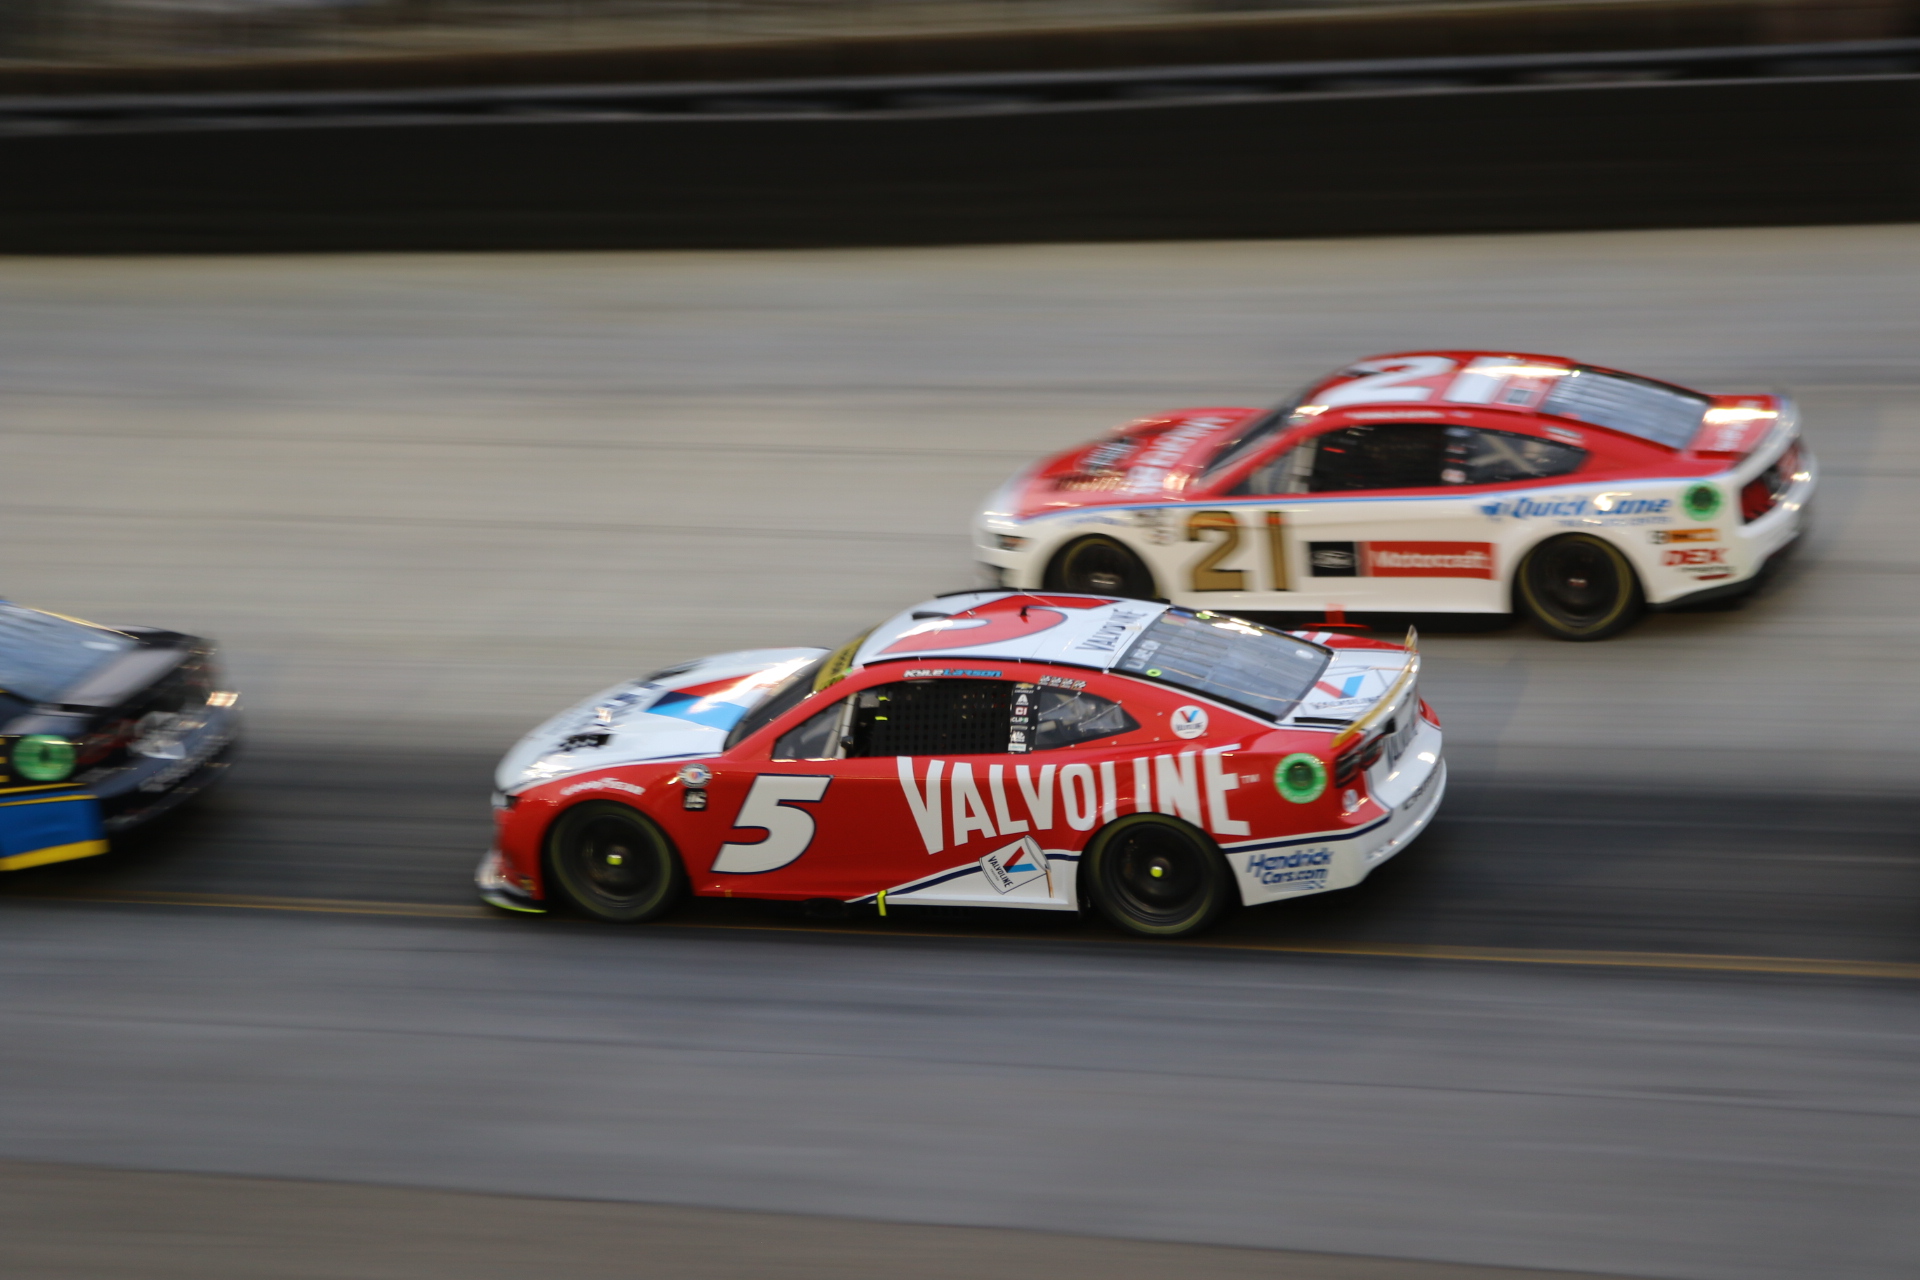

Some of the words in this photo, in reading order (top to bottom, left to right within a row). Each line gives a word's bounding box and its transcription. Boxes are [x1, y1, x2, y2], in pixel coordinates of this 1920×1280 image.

[1186, 510, 1291, 592] 21
[709, 772, 835, 875] 5
[896, 744, 1251, 855] VALVOLINE
[988, 855, 1014, 888] VALVOLINE
[1245, 847, 1335, 877] Hendrick
[1261, 868, 1328, 885] Cars.com
